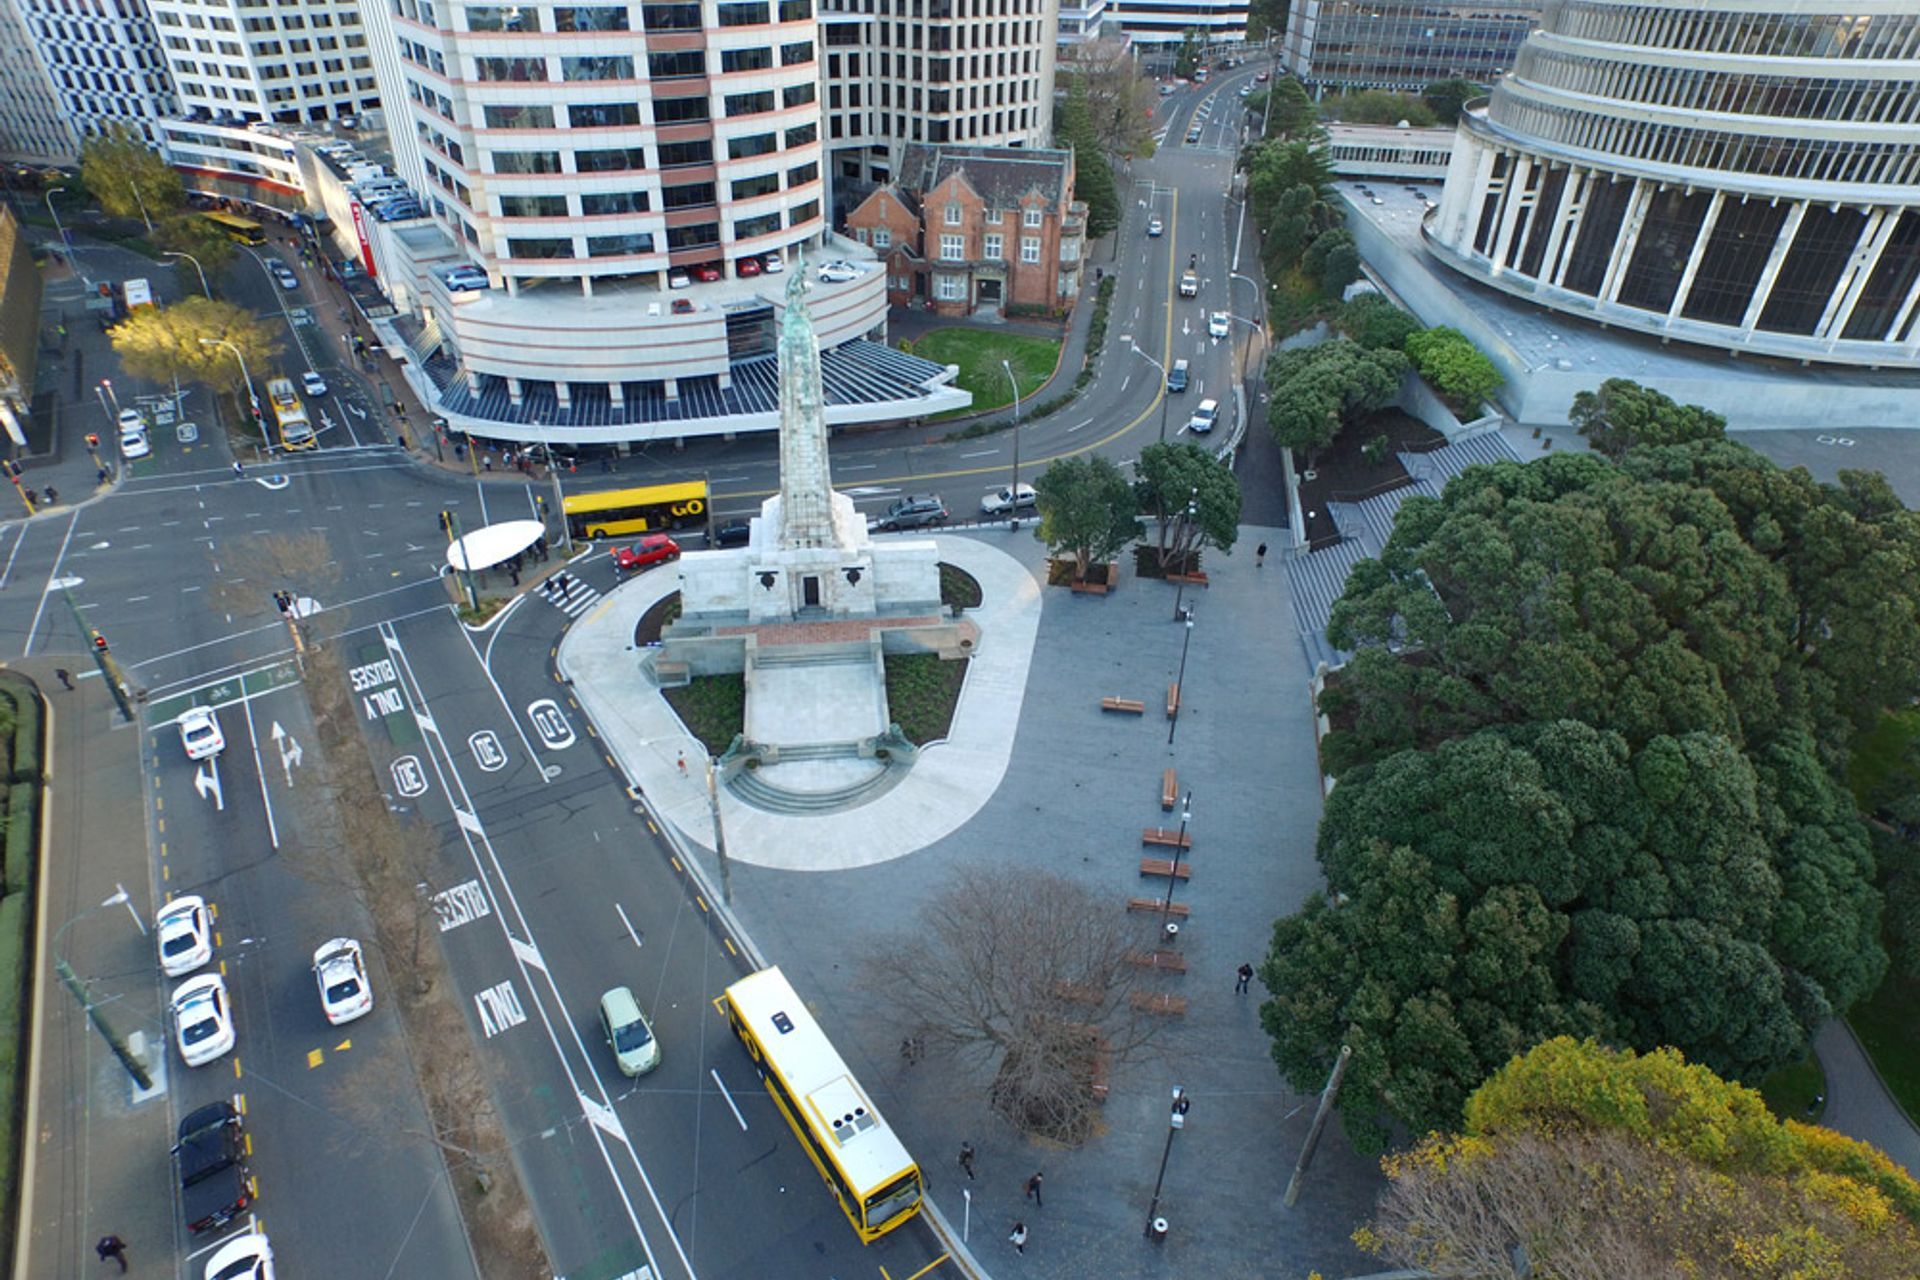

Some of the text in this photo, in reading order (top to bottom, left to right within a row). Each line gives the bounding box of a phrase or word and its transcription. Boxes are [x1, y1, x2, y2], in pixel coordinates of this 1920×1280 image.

[671, 500, 704, 516] GO
[349, 659, 396, 691] BUSES
[363, 688, 404, 720] ONLY
[474, 980, 527, 1039] ONLY
